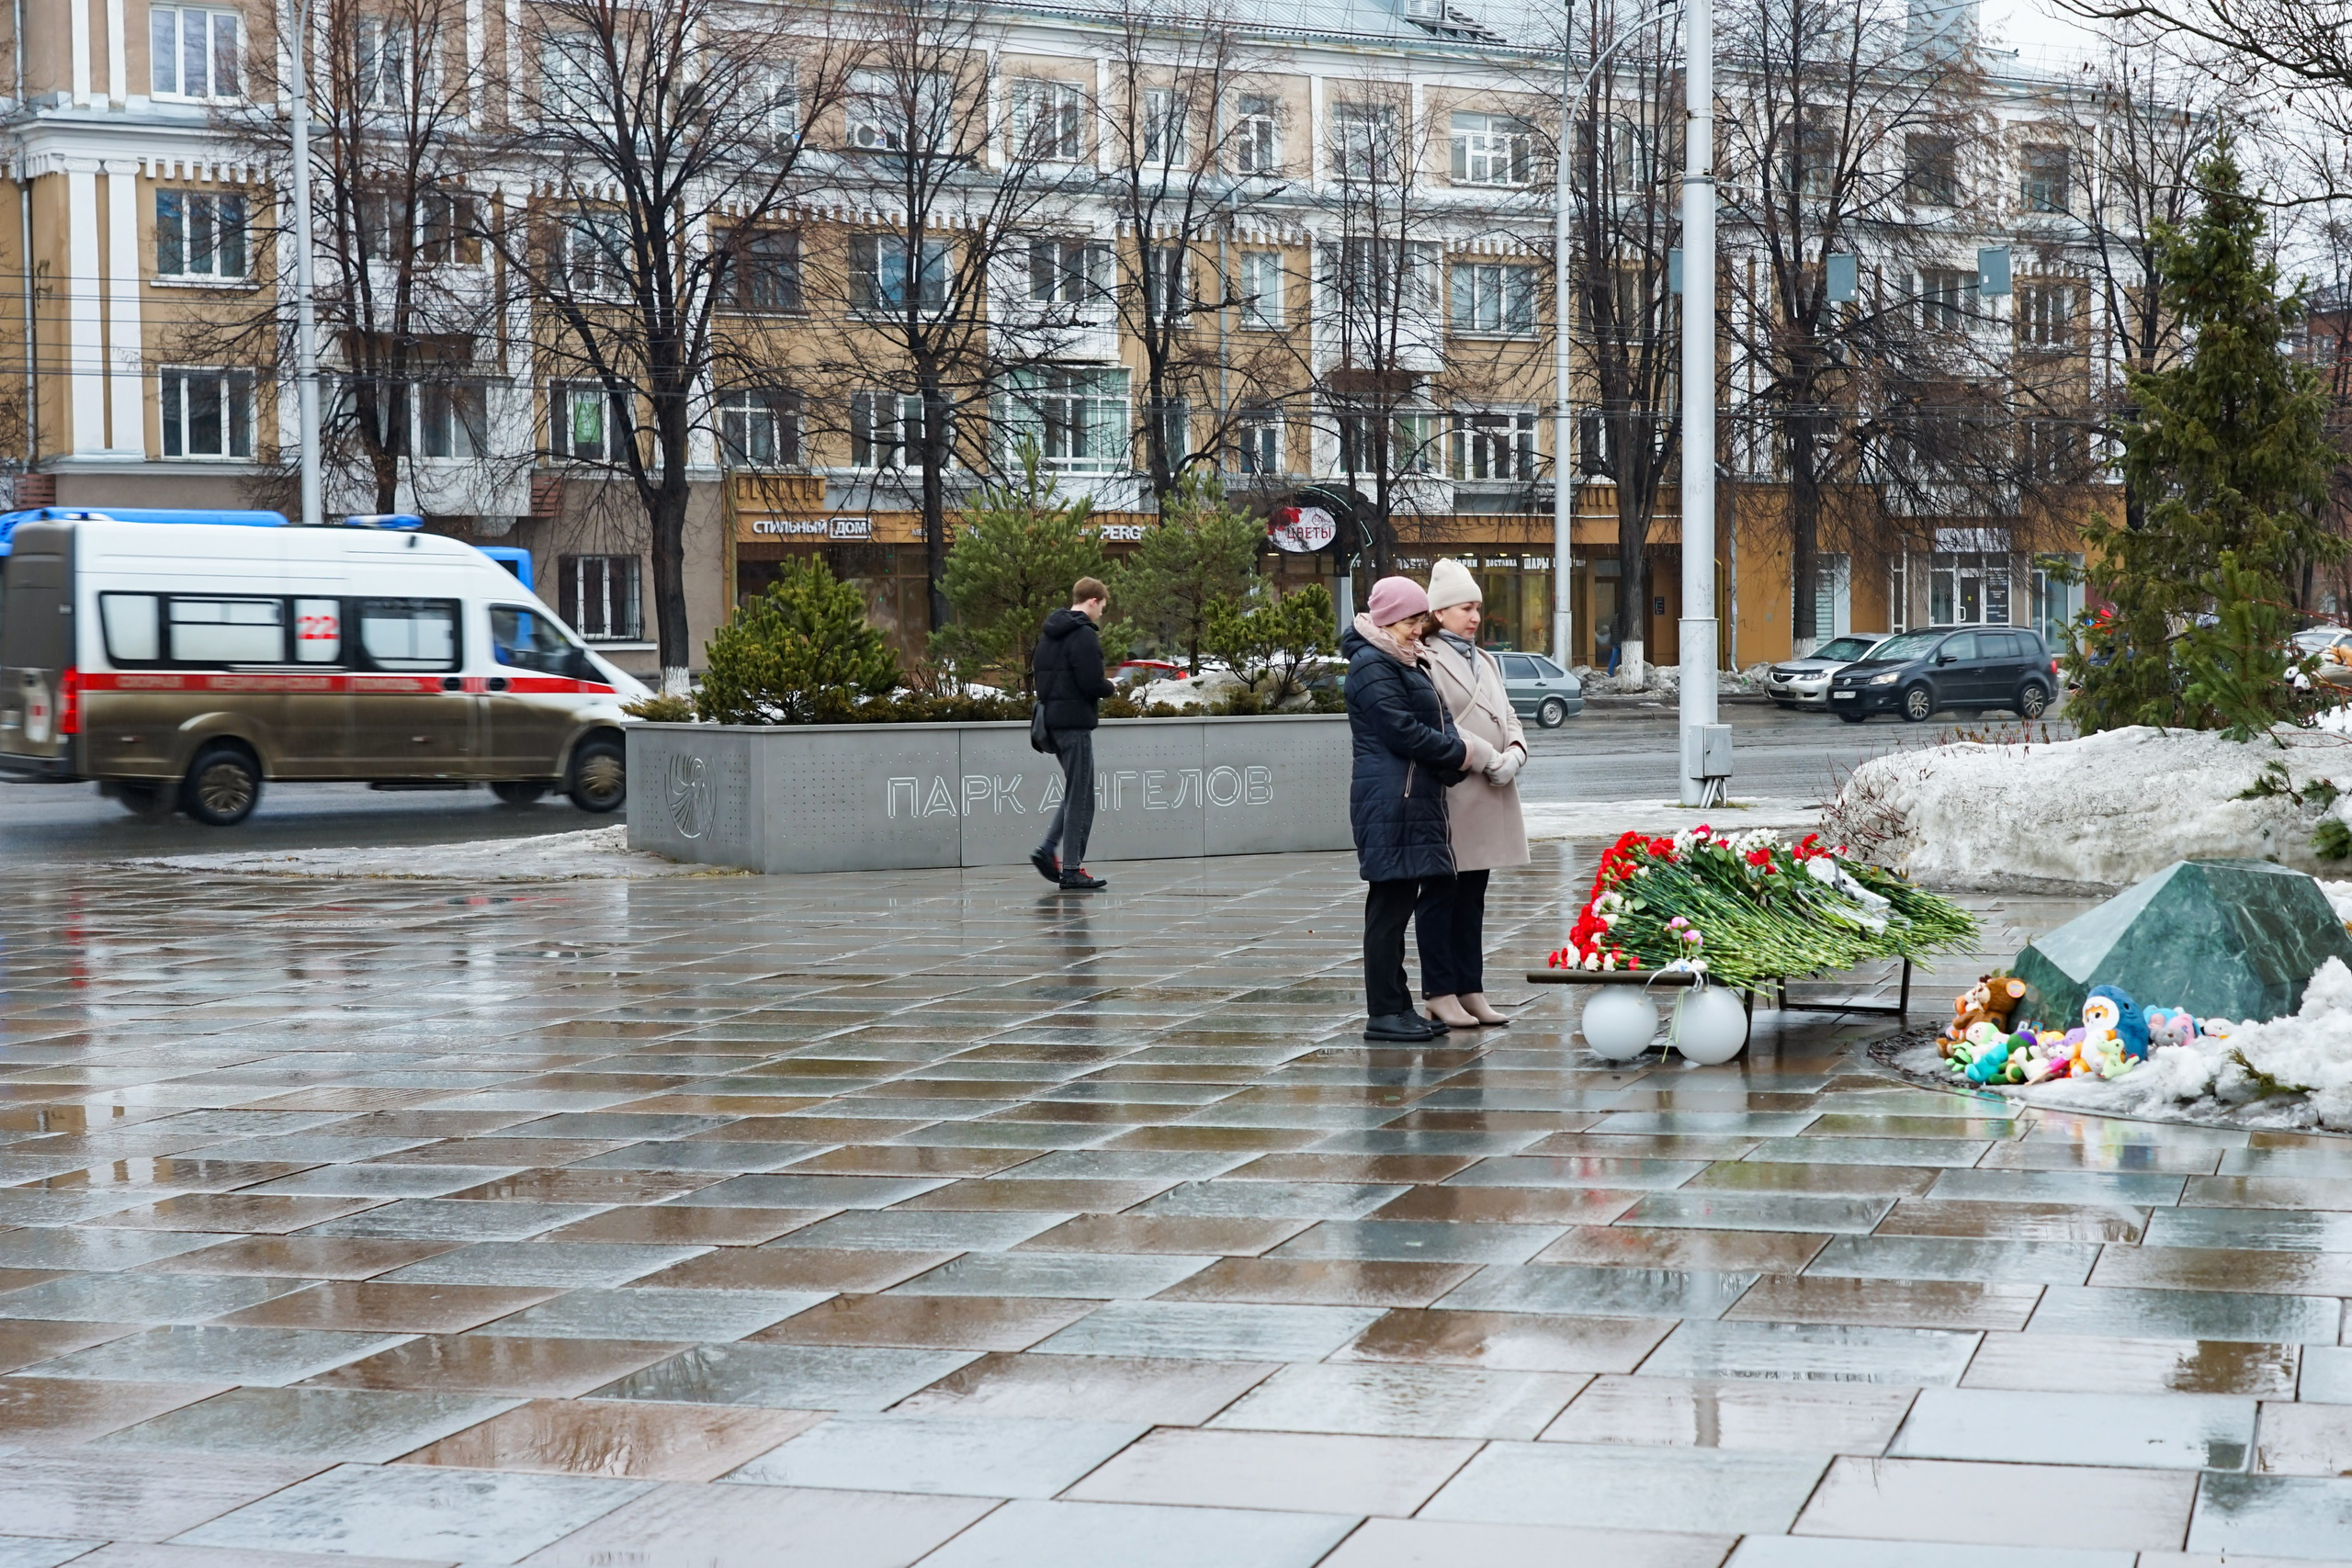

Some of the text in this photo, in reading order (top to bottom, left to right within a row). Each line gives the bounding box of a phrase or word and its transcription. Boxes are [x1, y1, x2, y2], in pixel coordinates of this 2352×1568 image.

[752, 519, 867, 536] СТИЛЬНЫЙ ДОМ
[1287, 526, 1331, 541] ЦВЕТЫ
[1485, 558, 1518, 568] ДОСТАВКА
[1523, 557, 1550, 570] ШАРЫ
[297, 615, 339, 640] 22
[887, 773, 1026, 818] ПАРК
